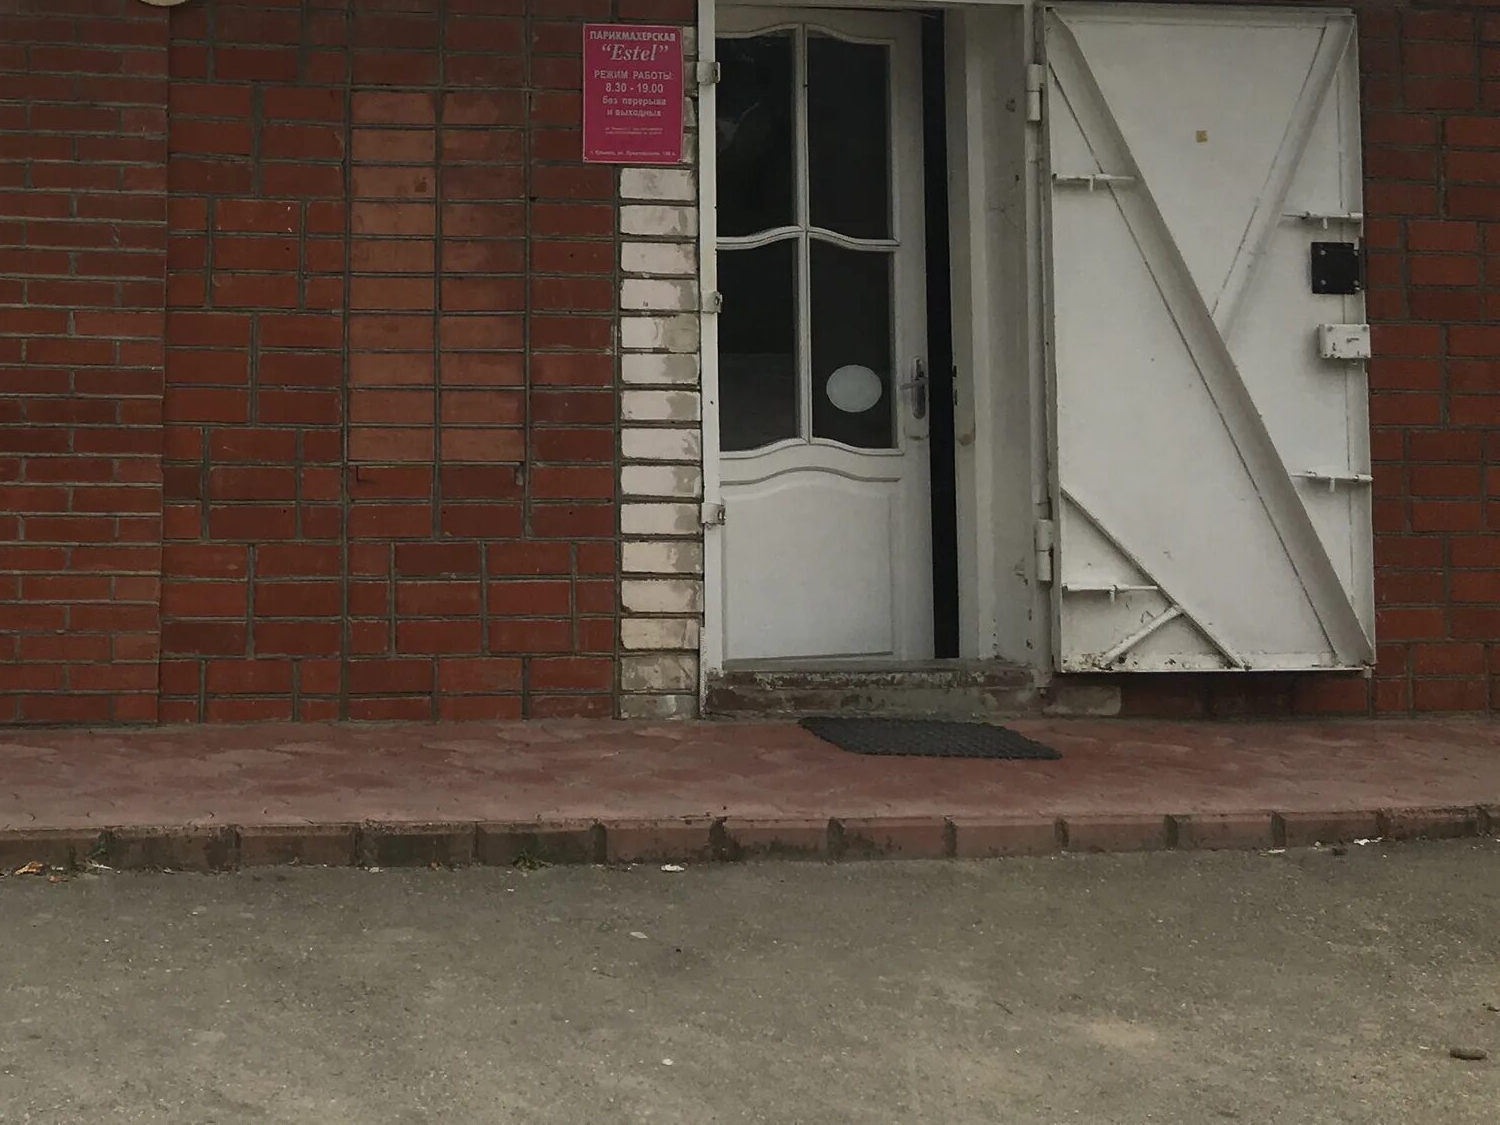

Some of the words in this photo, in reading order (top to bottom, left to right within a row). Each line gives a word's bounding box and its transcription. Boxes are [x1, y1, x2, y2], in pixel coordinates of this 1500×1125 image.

[590, 30, 676, 41] ПАРИКМАХЕРСКАЯ
[601, 43, 669, 61] “Estel”
[594, 69, 628, 79] РЕЖИМ
[605, 82, 627, 92] 8.30
[637, 83, 664, 93] 19.00
[602, 96, 618, 105] Без
